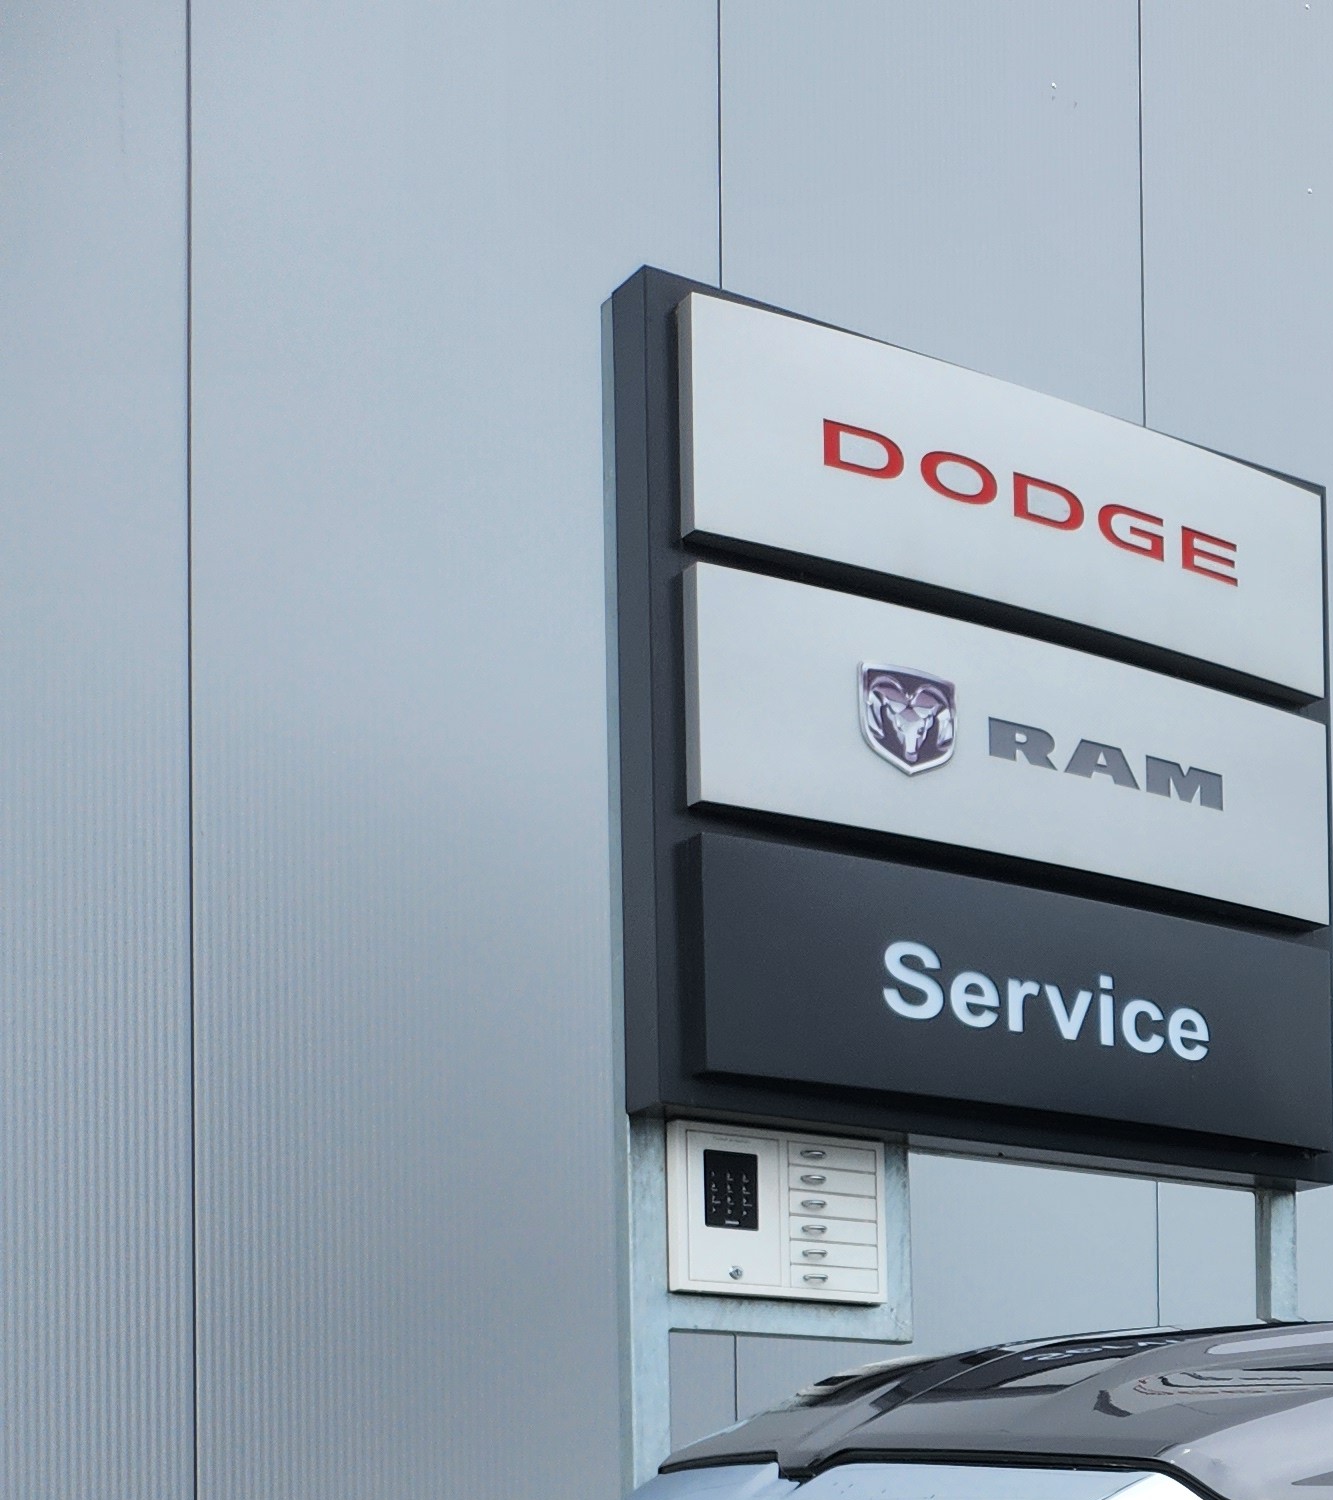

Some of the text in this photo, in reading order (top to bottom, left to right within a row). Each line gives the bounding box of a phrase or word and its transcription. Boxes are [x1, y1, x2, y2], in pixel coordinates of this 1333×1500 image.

[822, 417, 1239, 588] DODGE
[988, 716, 1224, 811] RAM
[882, 940, 1210, 1061] Service
